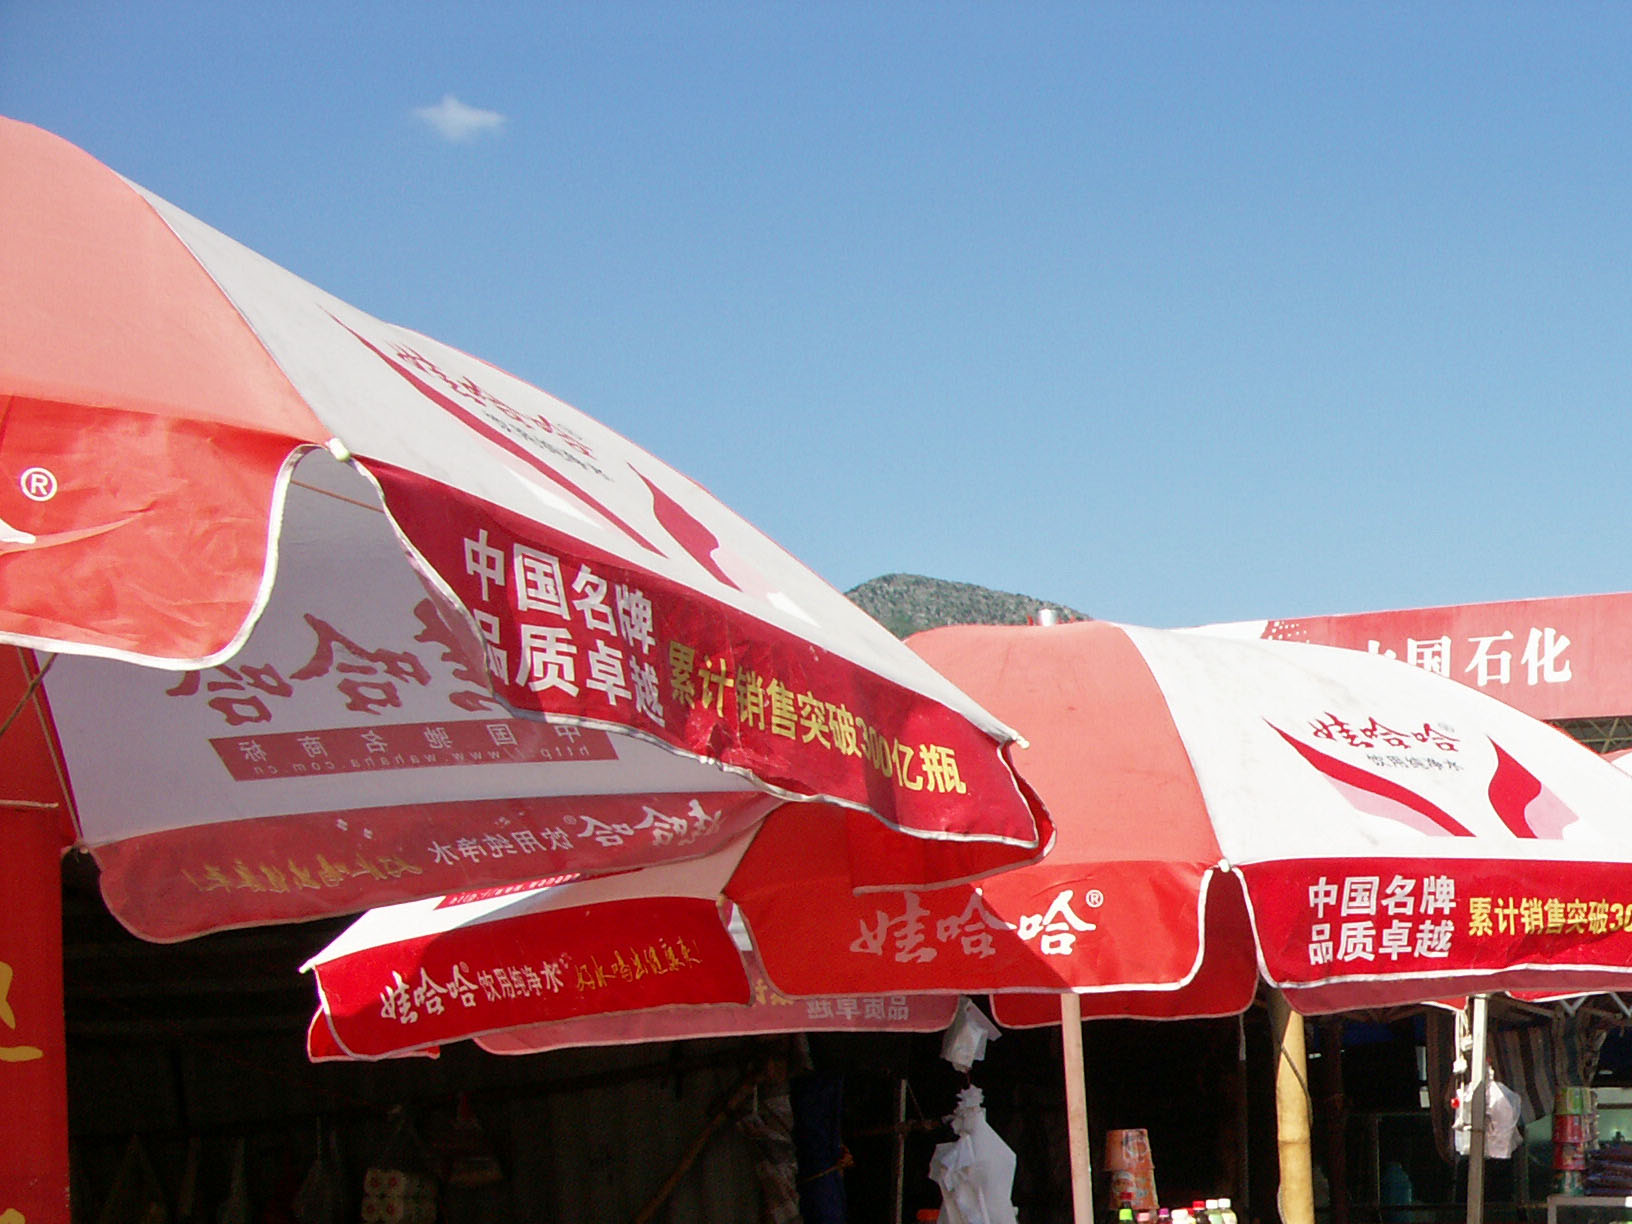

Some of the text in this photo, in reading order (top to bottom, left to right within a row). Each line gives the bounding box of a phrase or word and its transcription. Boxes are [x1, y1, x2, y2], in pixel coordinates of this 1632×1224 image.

[463, 528, 657, 655] 中国名牌
[472, 606, 667, 729] 品质卓越
[666, 640, 967, 796] 累计销售突破300亿瓶
[850, 888, 1097, 964] 娃哈哈
[1308, 874, 1457, 919] 中国名牌
[1308, 918, 1456, 966] 品质卓越
